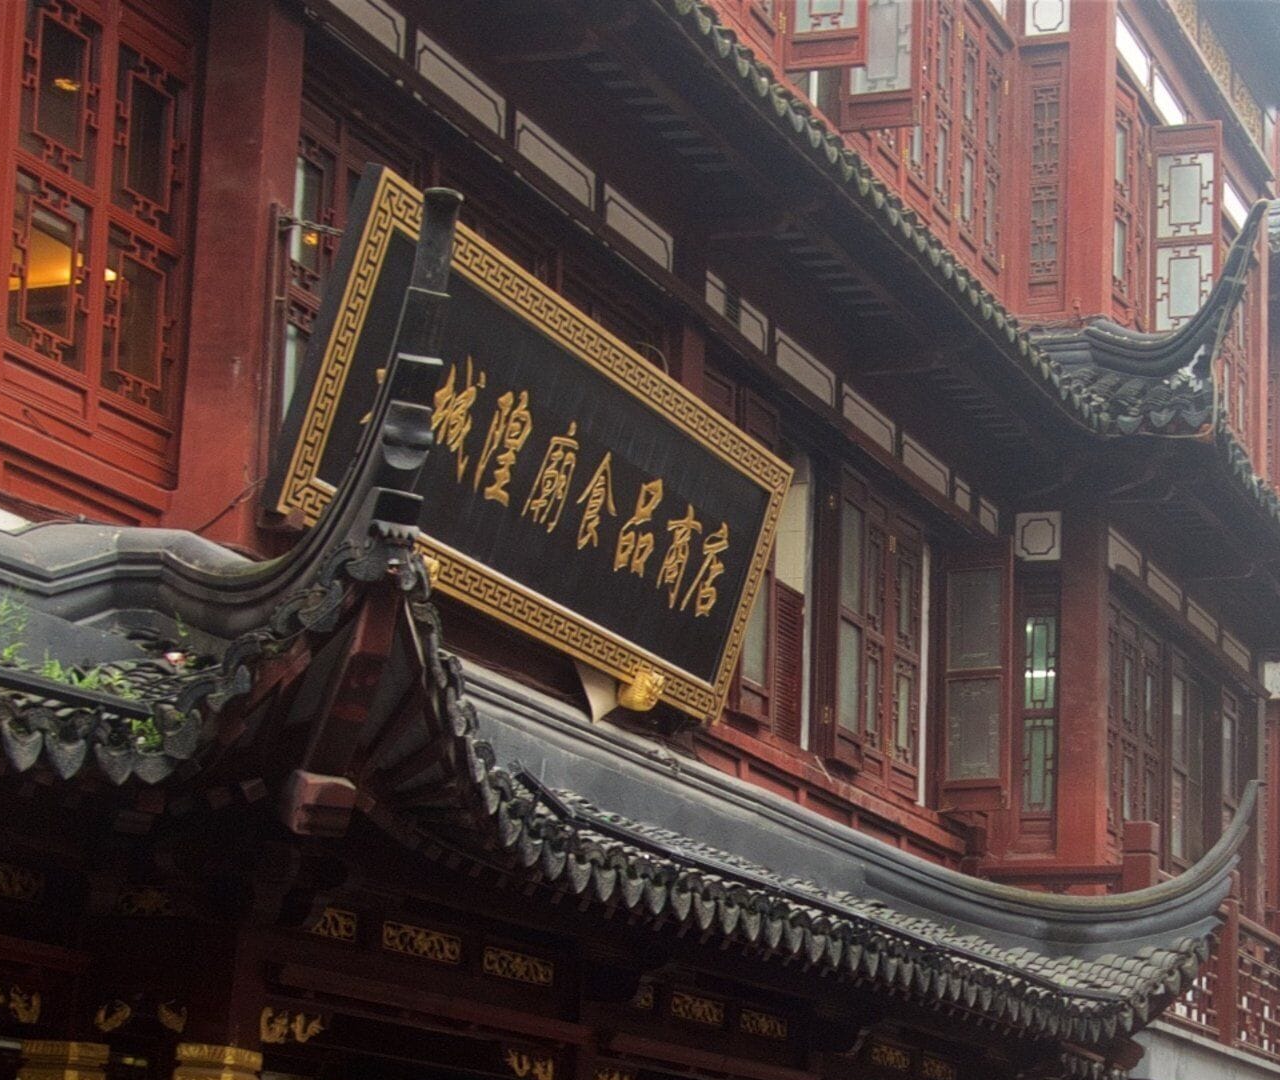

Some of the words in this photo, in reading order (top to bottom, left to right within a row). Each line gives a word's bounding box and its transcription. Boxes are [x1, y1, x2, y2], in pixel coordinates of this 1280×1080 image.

[360, 355, 729, 618] 城隍廟食品商店
